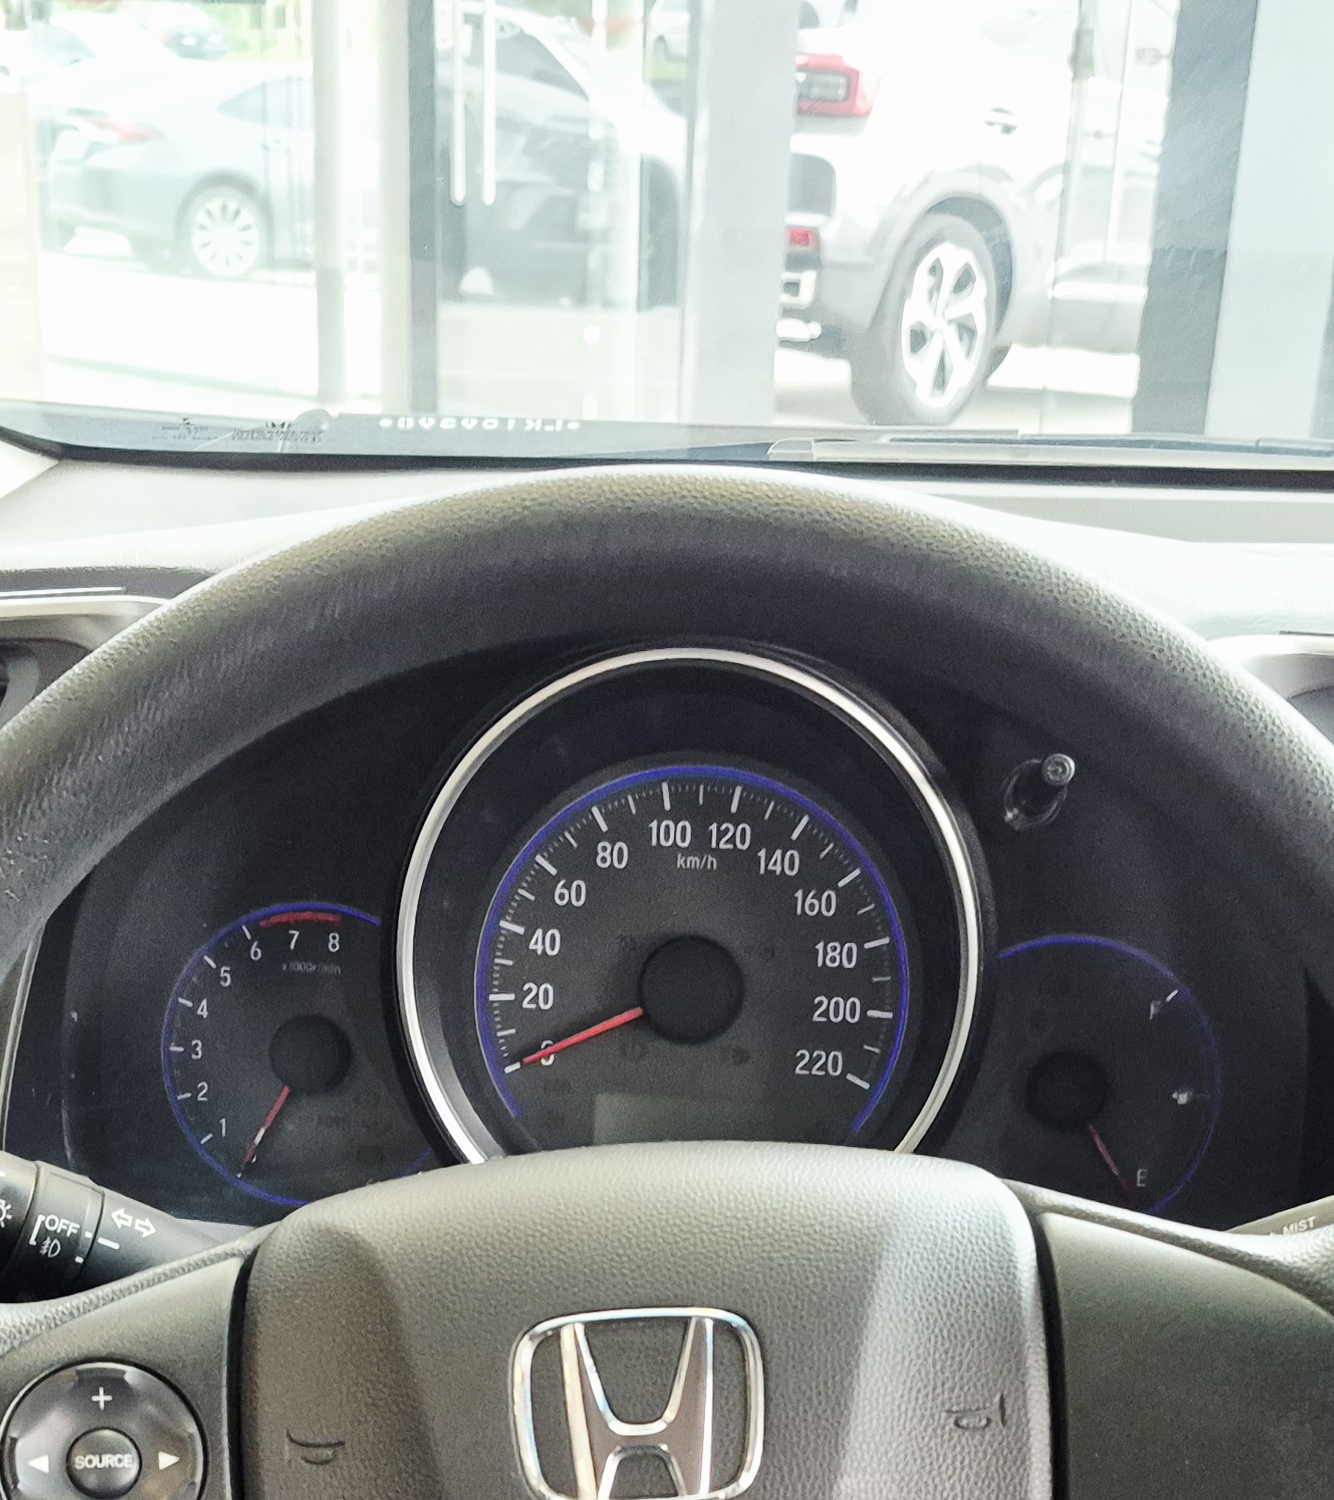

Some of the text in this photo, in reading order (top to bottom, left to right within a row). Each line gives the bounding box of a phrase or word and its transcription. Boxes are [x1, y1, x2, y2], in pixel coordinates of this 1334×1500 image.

[649, 821, 692, 848] 100
[709, 823, 751, 850] 120
[596, 842, 628, 870] 80
[677, 852, 717, 870] km/h
[757, 850, 799, 877] 140
[555, 881, 587, 907] 60
[795, 890, 836, 917] 160
[250, 941, 261, 960] 6
[289, 931, 299, 950] 7
[329, 932, 340, 952] 8
[529, 930, 561, 956] 40
[815, 942, 857, 969] 180
[220, 967, 231, 986] 5
[522, 983, 554, 1010] 20
[197, 999, 208, 1018] 4
[814, 996, 860, 1023] 200
[192, 1040, 202, 1059] 3
[795, 1051, 842, 1077] 220
[197, 1082, 208, 1101] 2
[219, 1118, 226, 1137] 1
[1137, 1169, 1147, 1187] E
[44, 1214, 79, 1237] OFF
[1283, 1217, 1315, 1236] MIST
[75, 1453, 133, 1470] SOURCE
